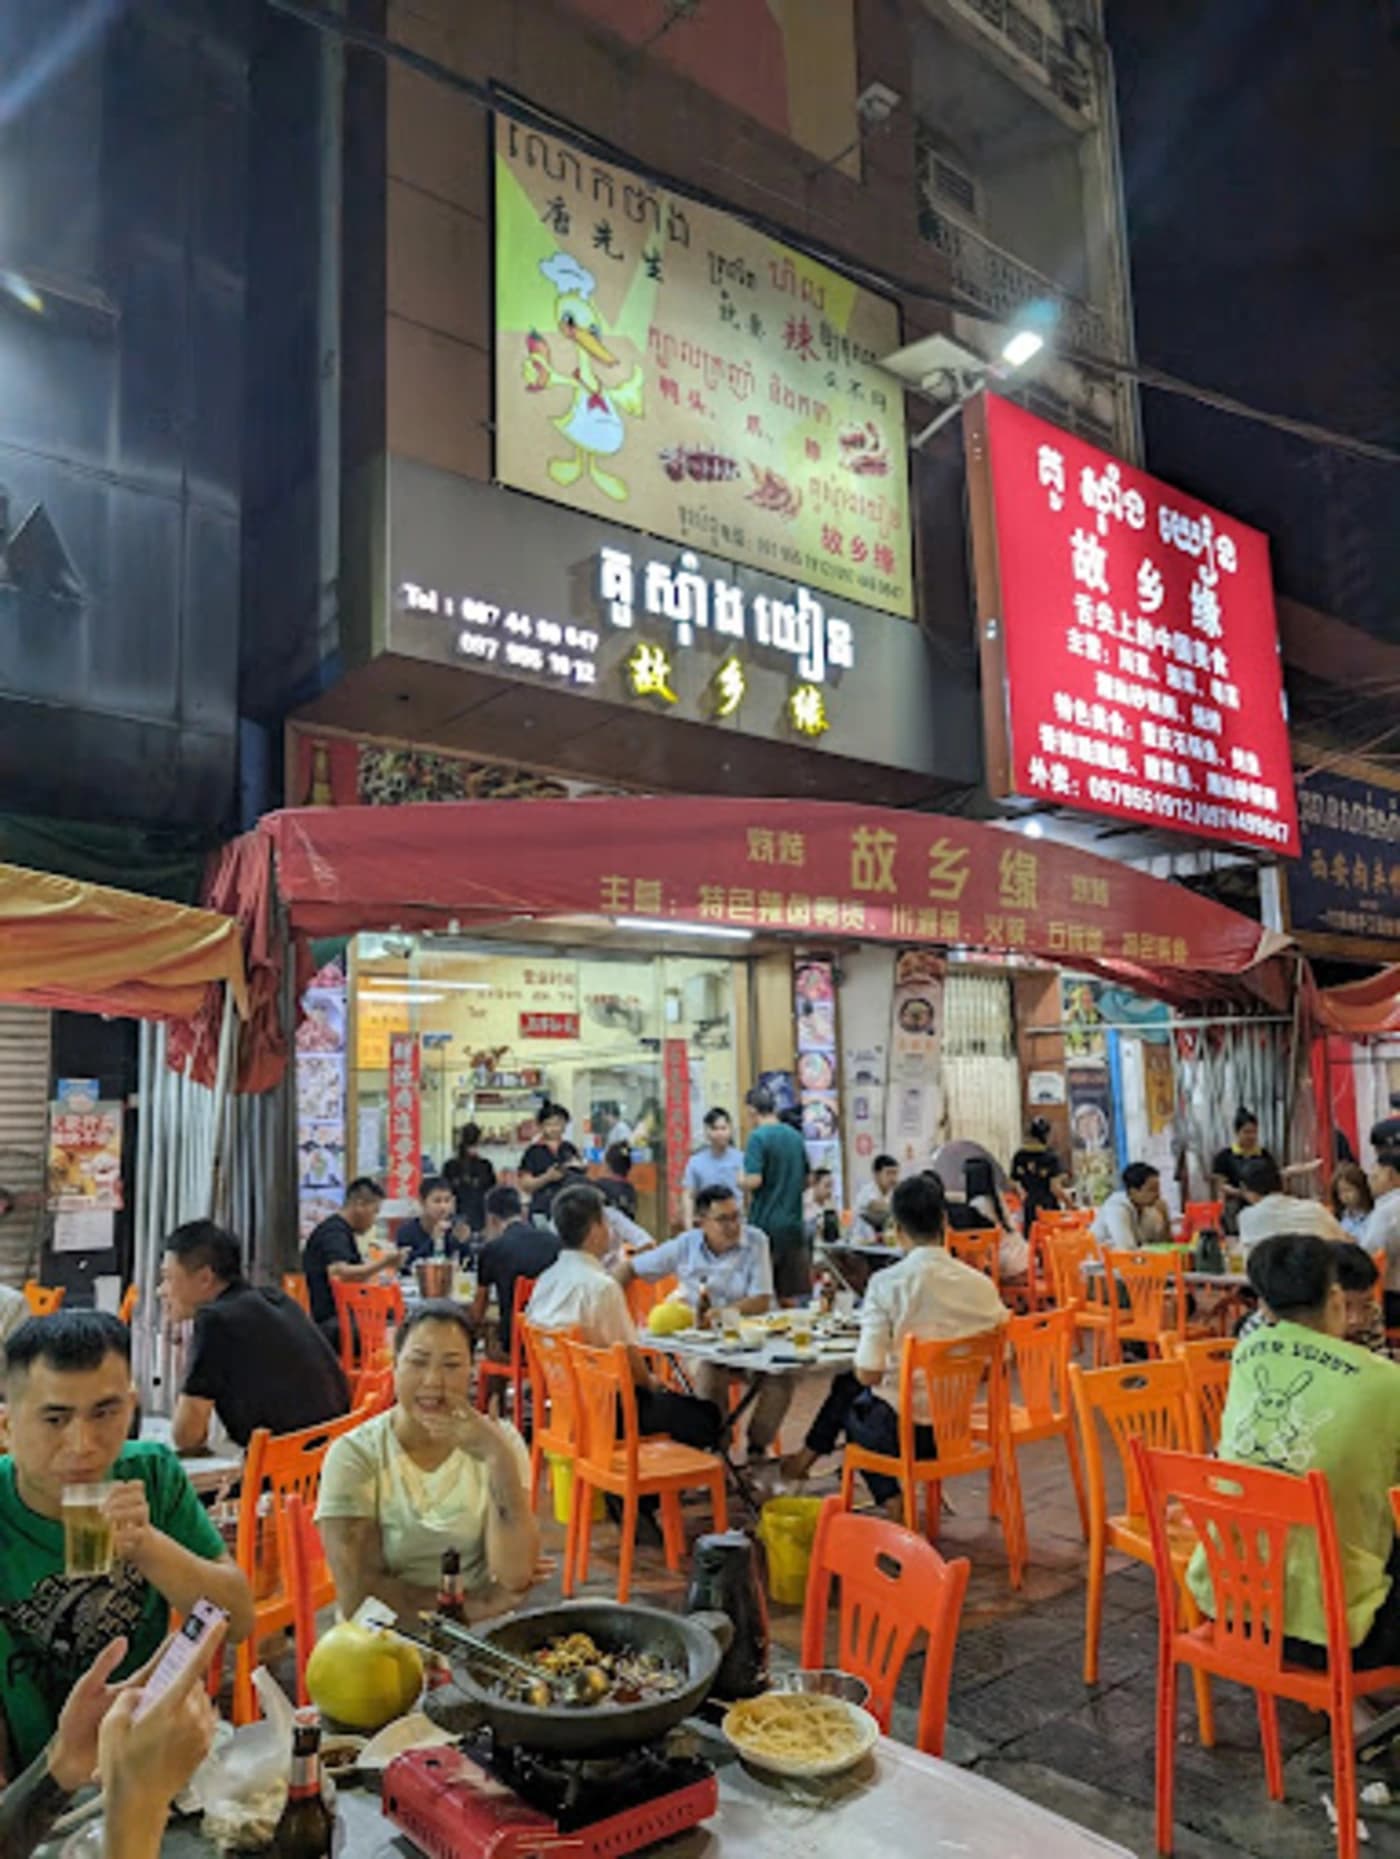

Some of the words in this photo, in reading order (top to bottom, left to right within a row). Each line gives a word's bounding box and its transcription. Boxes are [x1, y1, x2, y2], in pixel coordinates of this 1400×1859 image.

[821, 522, 896, 575] 故乡缘
[1070, 527, 1223, 638] 故乡缘
[402, 582, 438, 614] Tel
[505, 611, 533, 638] 44
[629, 643, 830, 737] 故乡缘
[746, 827, 807, 866] 烧烤
[850, 825, 1038, 910] 故乡缘
